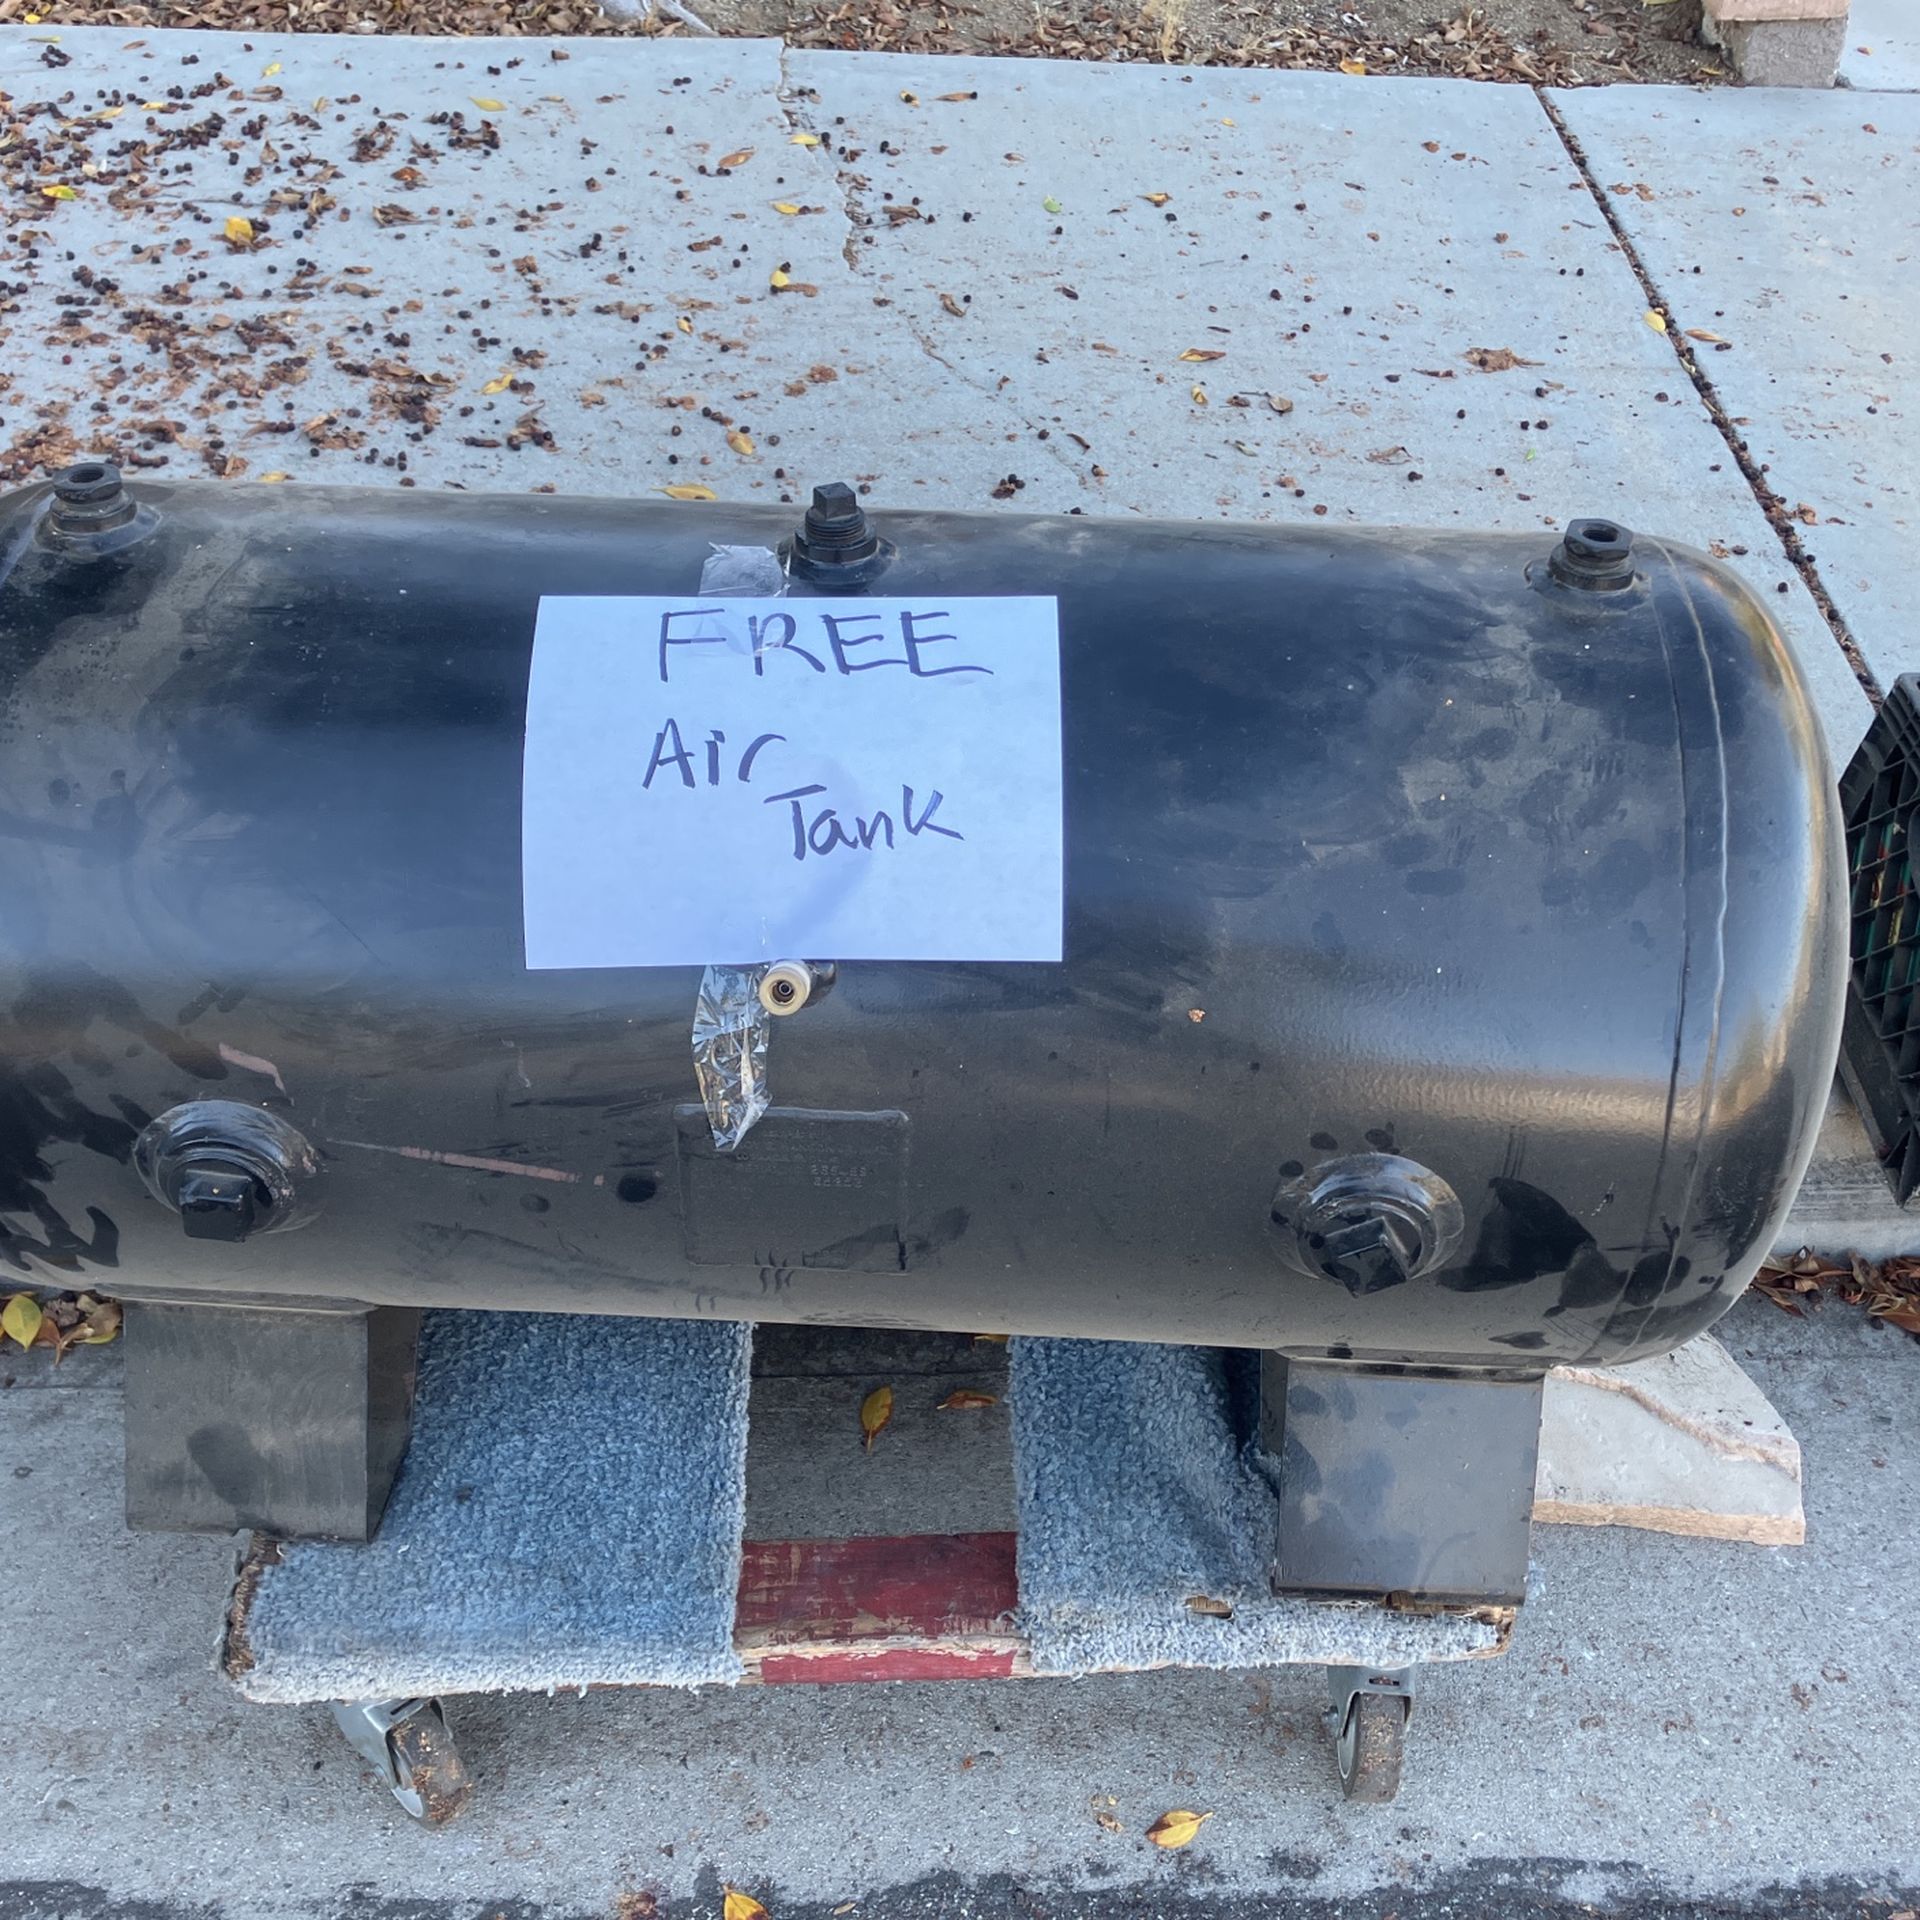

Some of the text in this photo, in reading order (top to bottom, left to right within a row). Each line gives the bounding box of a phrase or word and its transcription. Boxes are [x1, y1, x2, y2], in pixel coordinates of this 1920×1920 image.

[660, 608, 994, 682] FREE
[642, 718, 786, 789] Air
[763, 784, 964, 861] Tank
